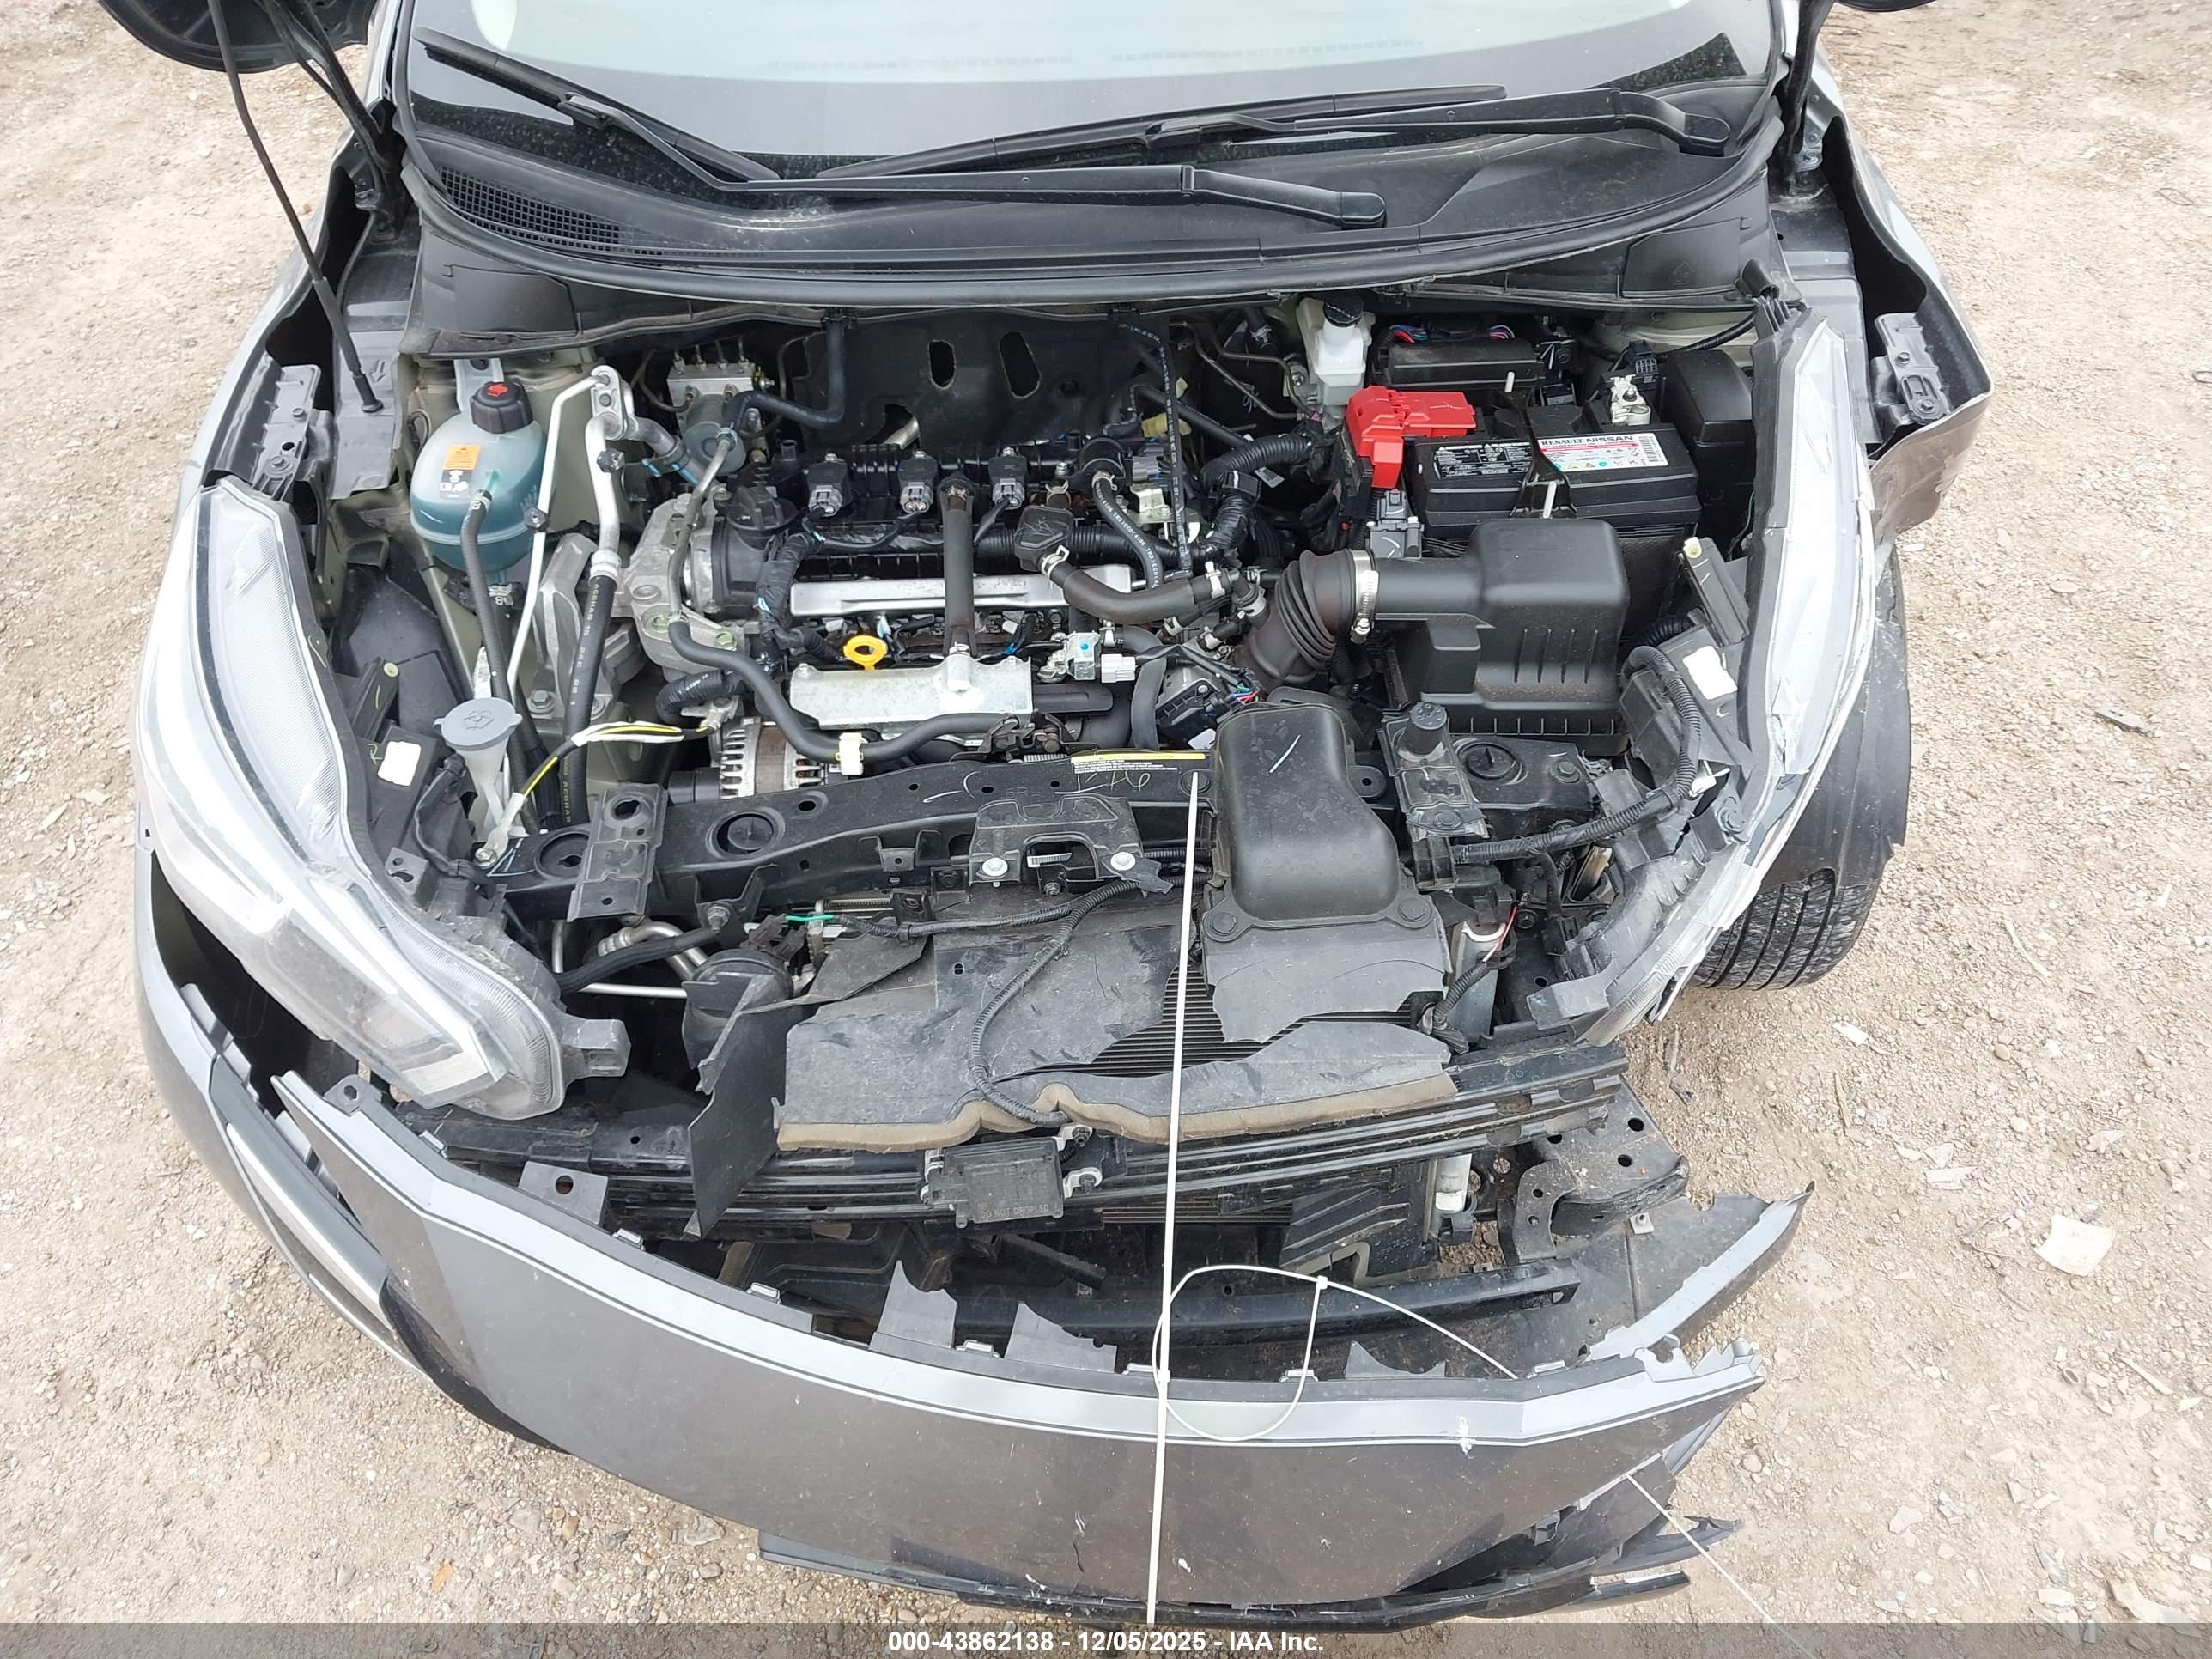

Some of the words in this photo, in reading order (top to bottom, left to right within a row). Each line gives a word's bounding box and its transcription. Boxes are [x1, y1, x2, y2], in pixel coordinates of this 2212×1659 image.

[1540, 437, 1583, 447] RENAULT
[1585, 434, 1634, 443] NISSAN
[994, 1207, 1011, 1217] NOT
